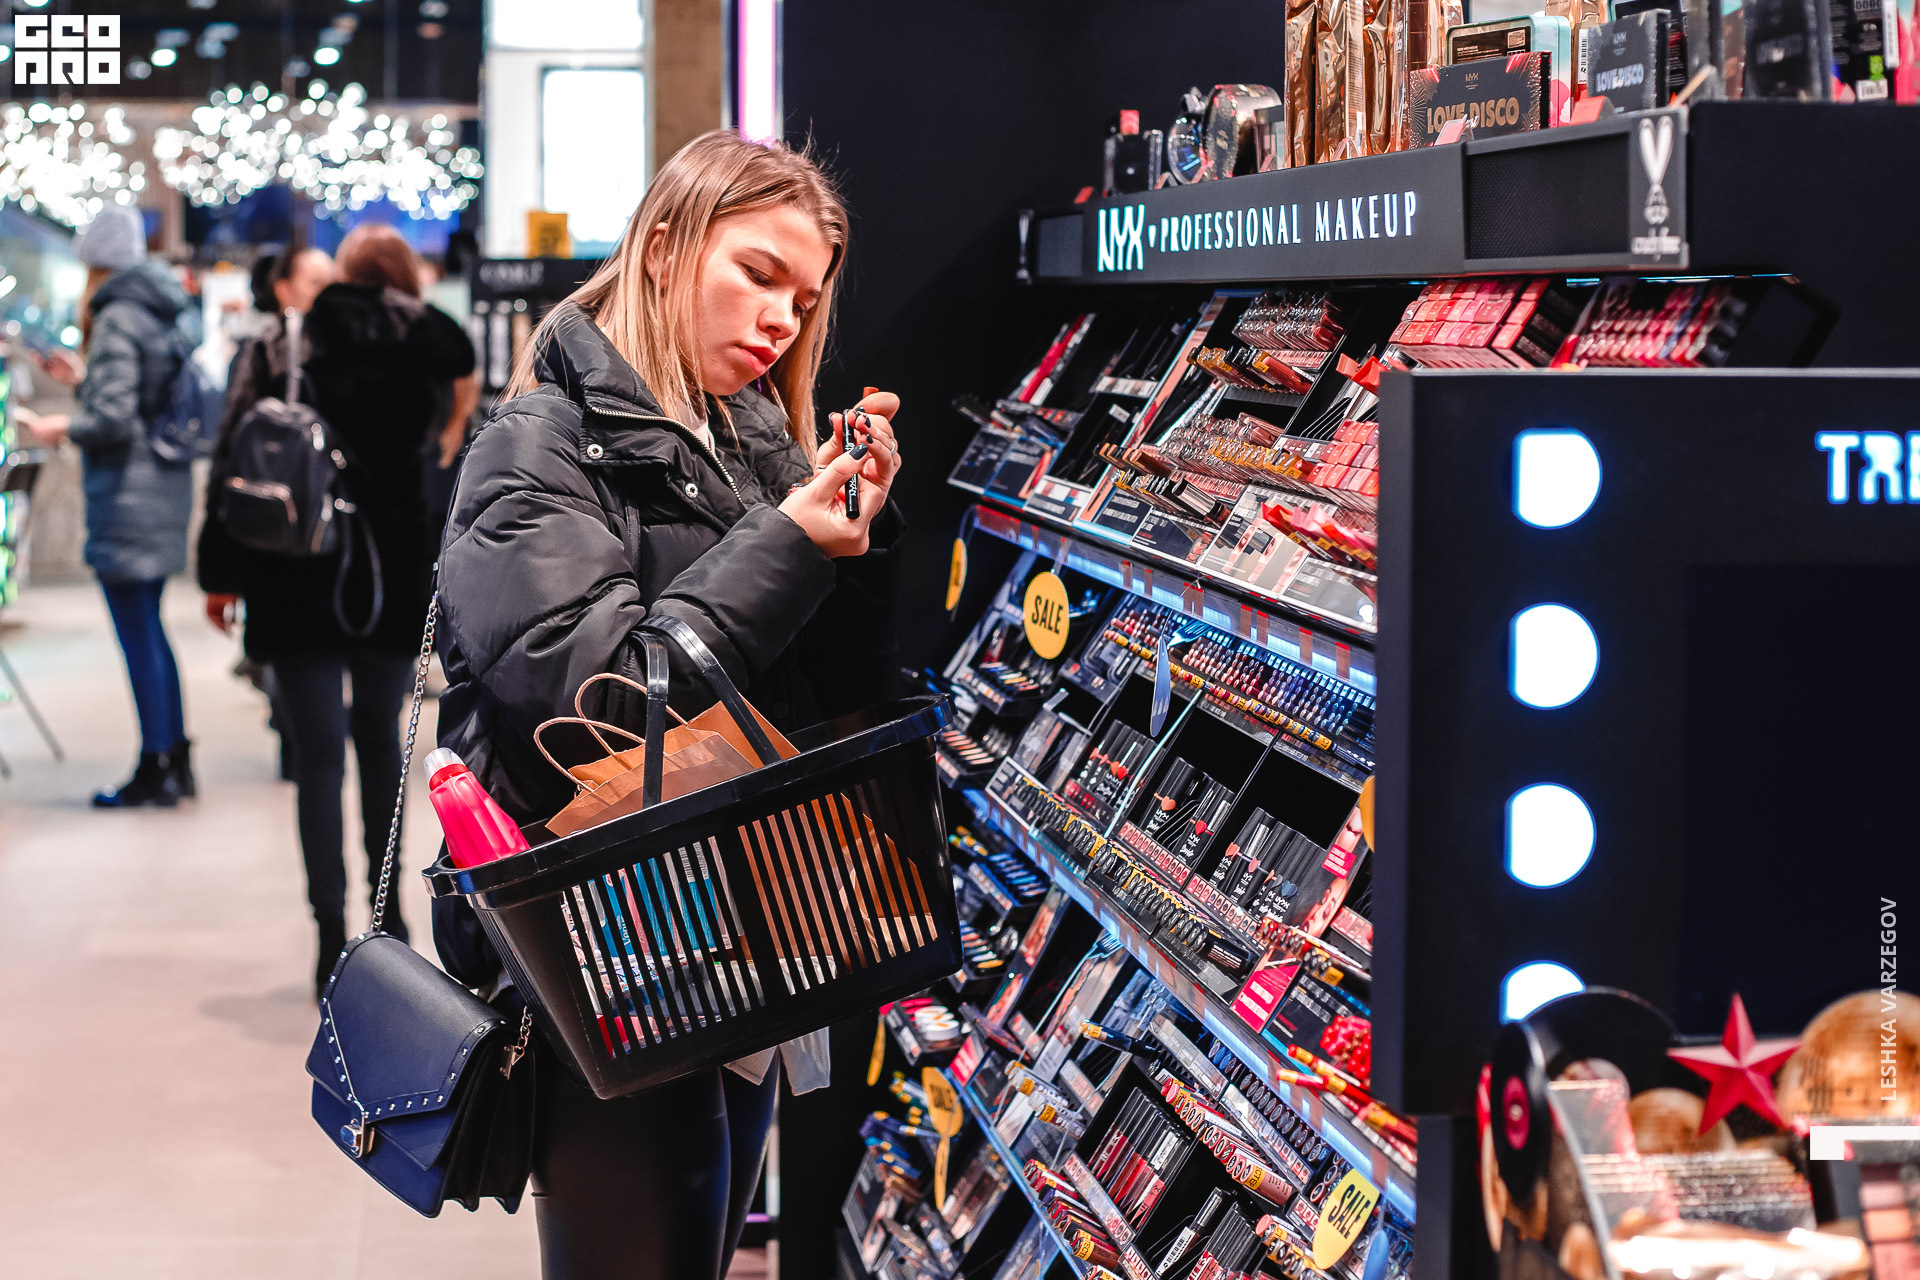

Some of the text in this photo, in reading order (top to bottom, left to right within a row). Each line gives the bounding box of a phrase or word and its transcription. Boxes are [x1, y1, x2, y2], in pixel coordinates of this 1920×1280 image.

[1469, 96, 1520, 129] DISCO
[1097, 191, 1417, 273] NYX PROFESSIONAL MAKEUP
[1031, 595, 1064, 635] SALE
[1328, 1183, 1372, 1240] SALE
